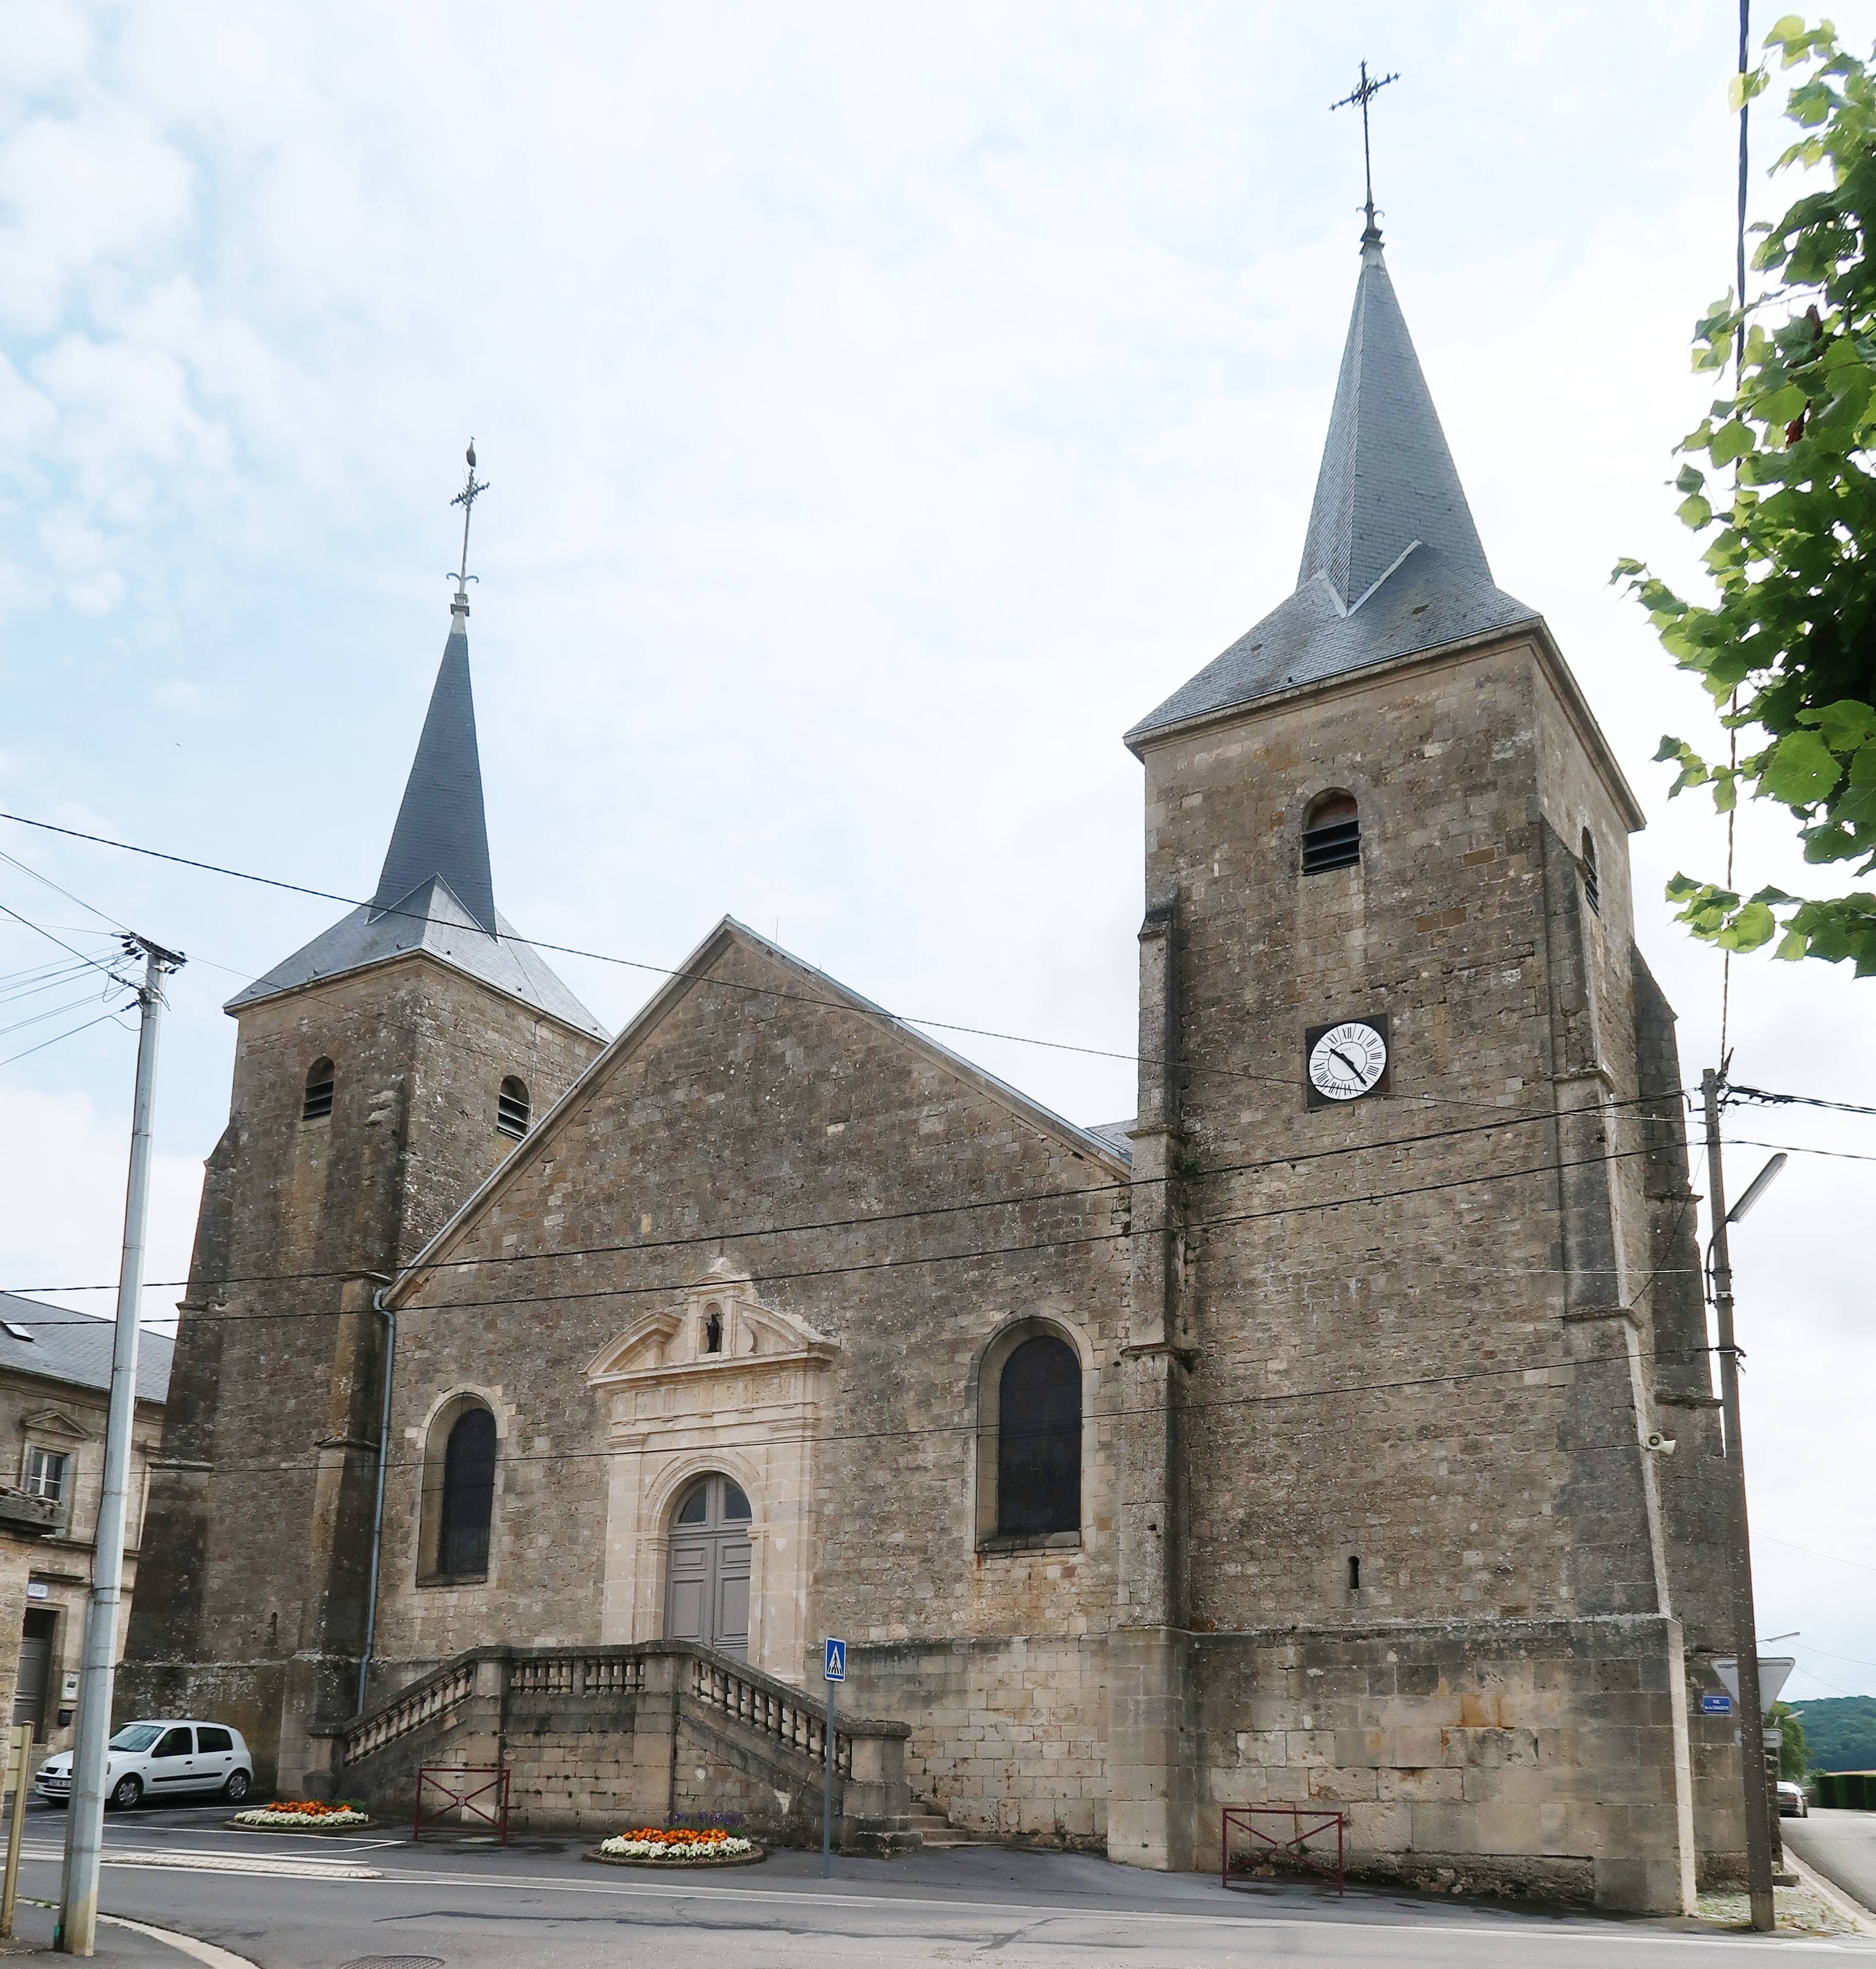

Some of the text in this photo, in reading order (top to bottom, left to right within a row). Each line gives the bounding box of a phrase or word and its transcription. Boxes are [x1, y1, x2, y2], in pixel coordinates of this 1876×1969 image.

[1342, 1027, 1351, 1040] XII
[1358, 1029, 1364, 1040] I
[1327, 1033, 1338, 1046] XI
[1366, 1038, 1378, 1047] II
[1313, 1061, 1325, 1071] IX
[1366, 1065, 1380, 1076] IIII
